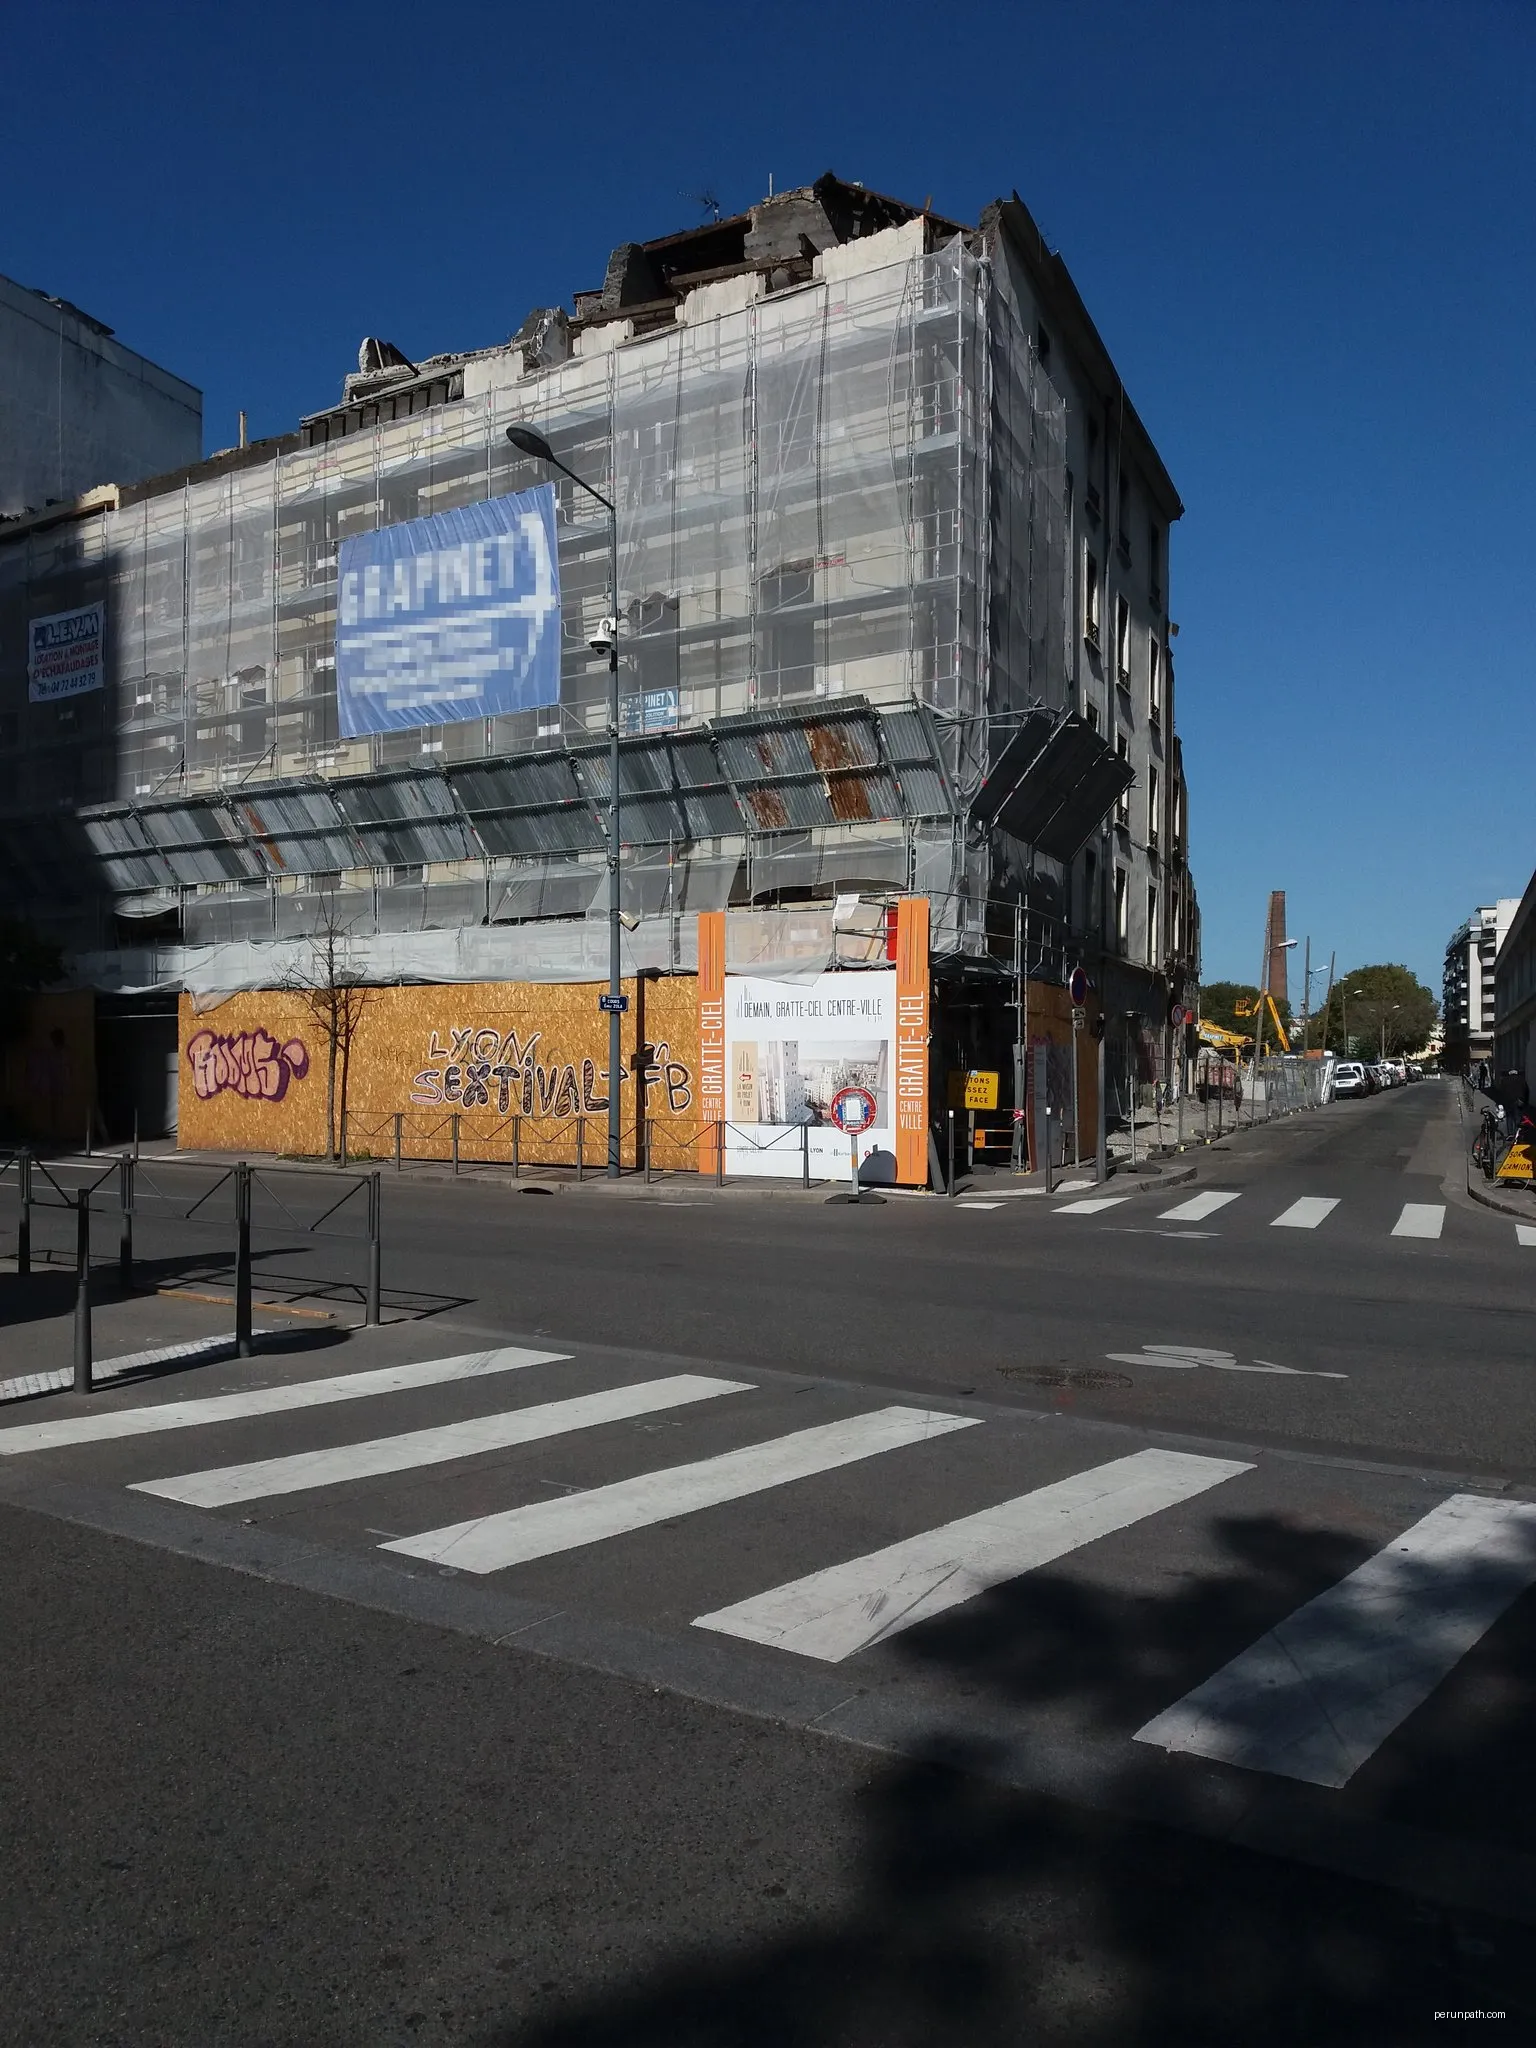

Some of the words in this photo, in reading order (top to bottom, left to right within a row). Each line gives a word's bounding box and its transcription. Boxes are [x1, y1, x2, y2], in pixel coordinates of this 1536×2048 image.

[79, 673, 87, 687] 32
[88, 671, 96, 685] 79
[744, 1001, 772, 1019] DEMAIN,
[776, 1000, 823, 1018] GRATTE-CIEL
[827, 998, 882, 1017] CENTRE-VILLE
[429, 1027, 542, 1067] LYON
[701, 996, 723, 1094] GRATTE-CIEL
[898, 990, 924, 1096] GRATTE-CIEL
[702, 1097, 722, 1110] CENTRE
[899, 1100, 923, 1114] CENTRE
[969, 1096, 989, 1104] FACE
[702, 1109, 722, 1124] VILLE
[899, 1114, 923, 1130] VILLE
